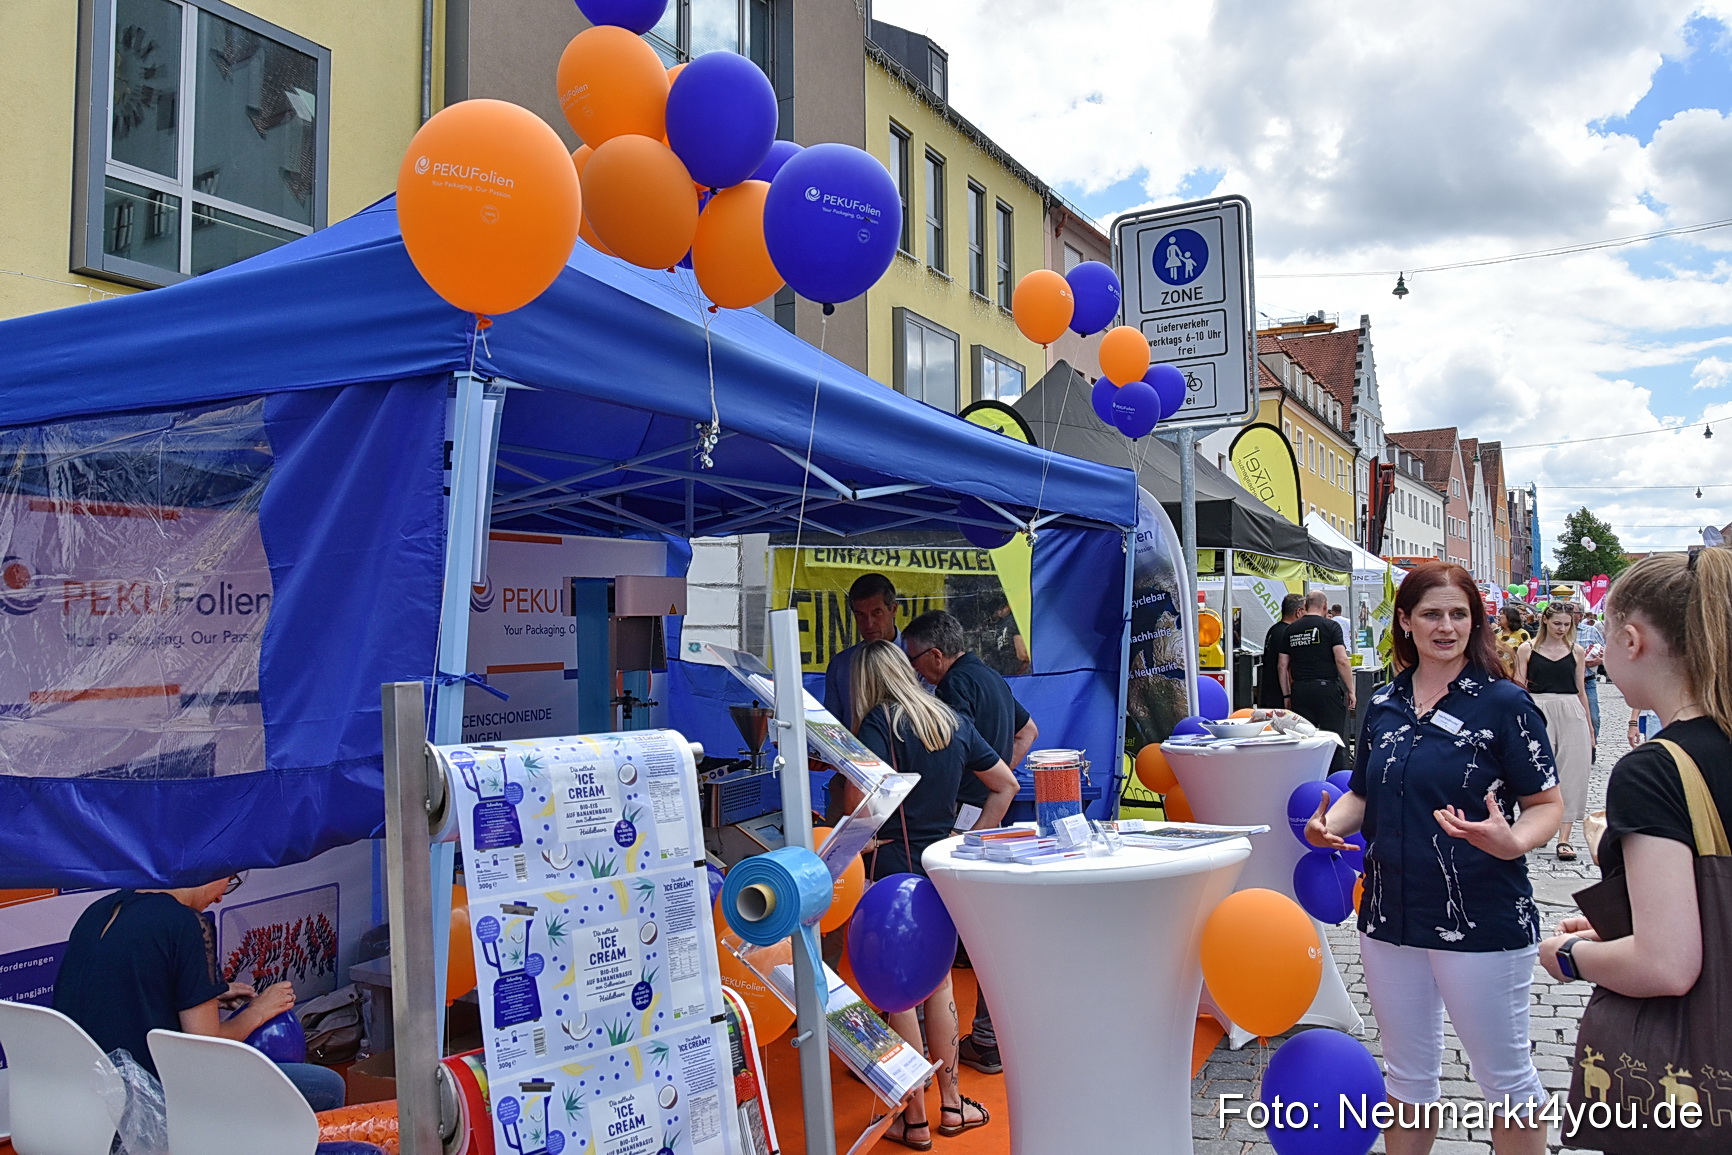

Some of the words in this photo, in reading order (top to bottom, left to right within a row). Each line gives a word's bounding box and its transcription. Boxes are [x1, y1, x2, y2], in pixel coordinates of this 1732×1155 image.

[432, 162, 515, 189] PEKUFolien
[822, 194, 881, 217] PEKUFolien
[1160, 286, 1204, 306] ZONE
[1156, 318, 1210, 334] Lieferverkehr
[1149, 336, 1183, 348] werktags
[1185, 331, 1205, 343] 6-10
[1207, 329, 1222, 340] Uhr
[1178, 346, 1196, 356] frei
[814, 547, 900, 568] EINFACH
[906, 548, 995, 572] AUFALE
[191, 630, 217, 645] Our
[504, 624, 523, 636] Your
[525, 623, 567, 638] Packaging.
[1135, 660, 1178, 681] Neumarkt
[462, 707, 552, 729] CENSCHONENDE
[568, 784, 605, 800] CREAM
[565, 811, 576, 819] AUF
[576, 807, 613, 818] BANANENBASIS
[579, 803, 599, 811] BIO-EIS
[673, 879, 694, 891] CREAM?
[589, 946, 627, 966] CREAM
[596, 970, 633, 984] BANANENBASIS
[599, 966, 619, 976] BIO-EIS
[721, 975, 766, 992] PEKUFolien
[688, 1036, 711, 1050] CREAM?
[607, 1113, 646, 1137] CREAM
[615, 1136, 654, 1154] BANANENBASIS
[619, 1135, 639, 1147] BIO-EIS
